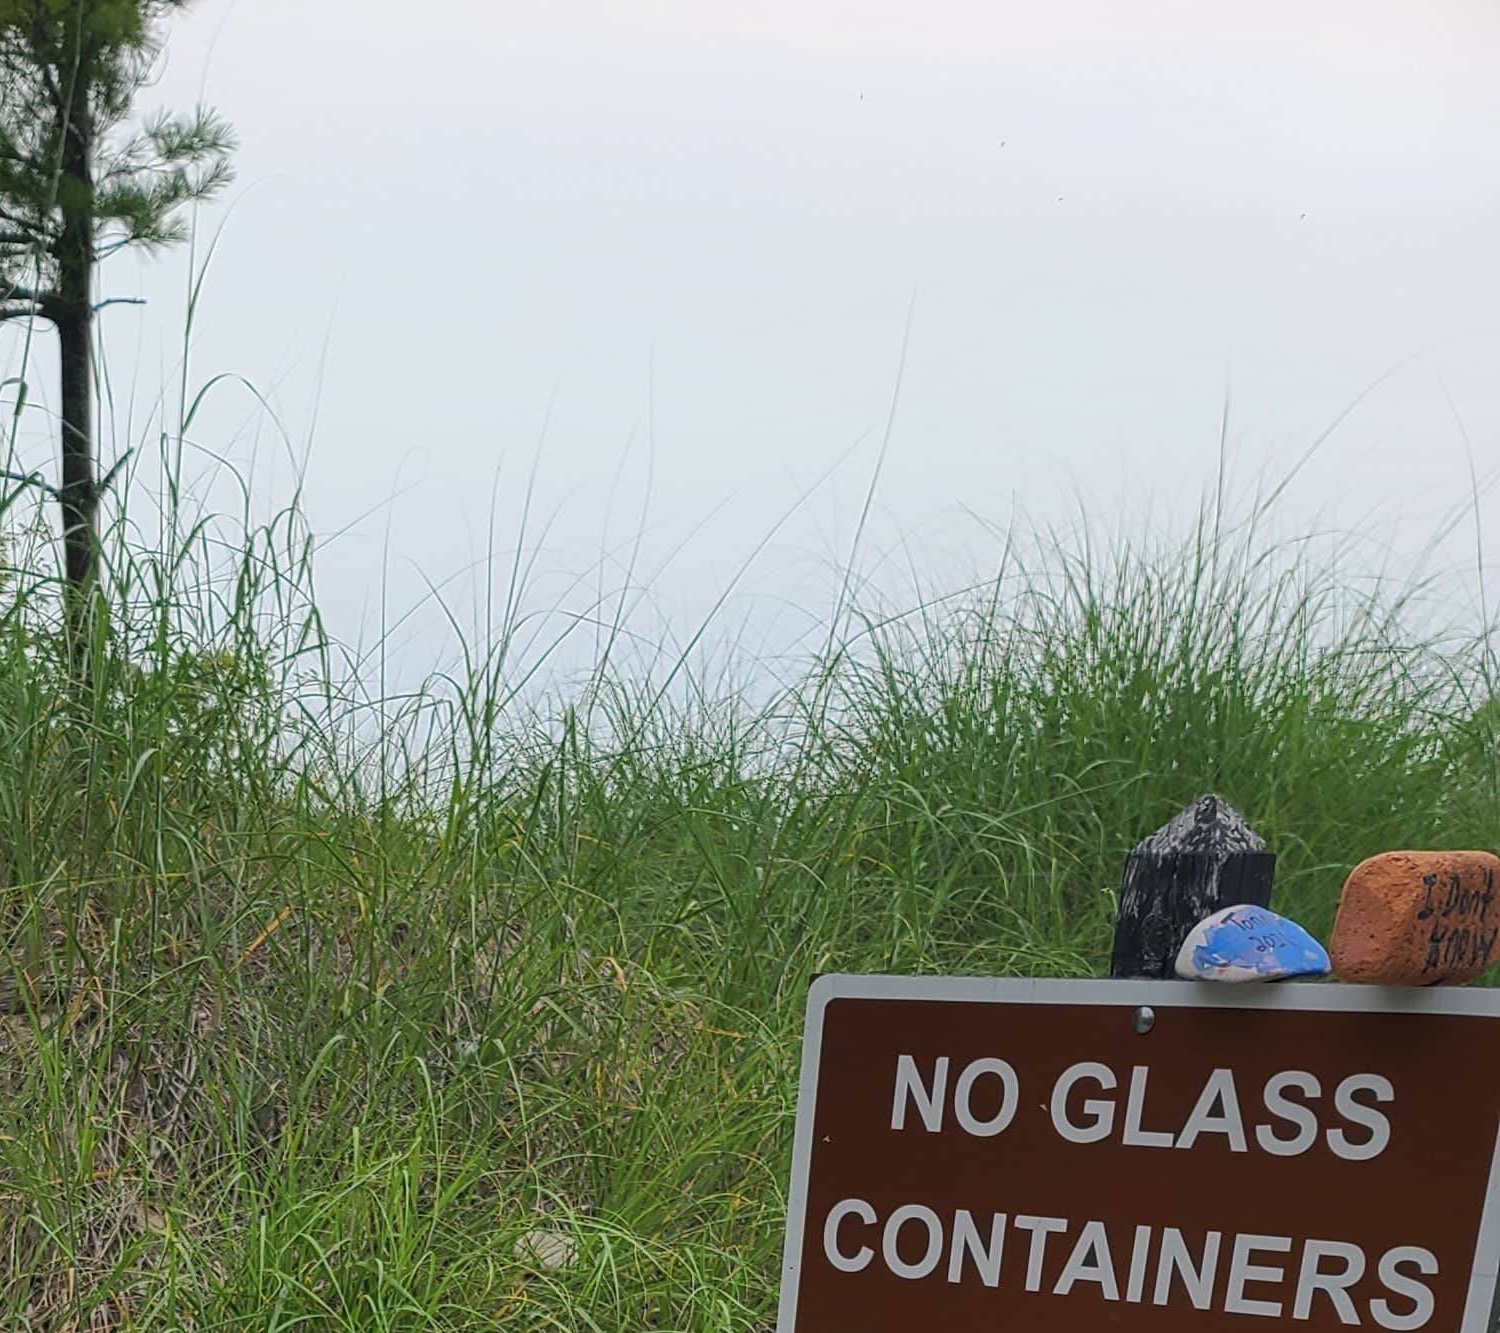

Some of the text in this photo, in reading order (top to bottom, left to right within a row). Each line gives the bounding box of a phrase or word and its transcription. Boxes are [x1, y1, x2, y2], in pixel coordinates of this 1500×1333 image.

[889, 1053, 1397, 1162] NO GLASS
[821, 1197, 1440, 1333] CONTAINERS
